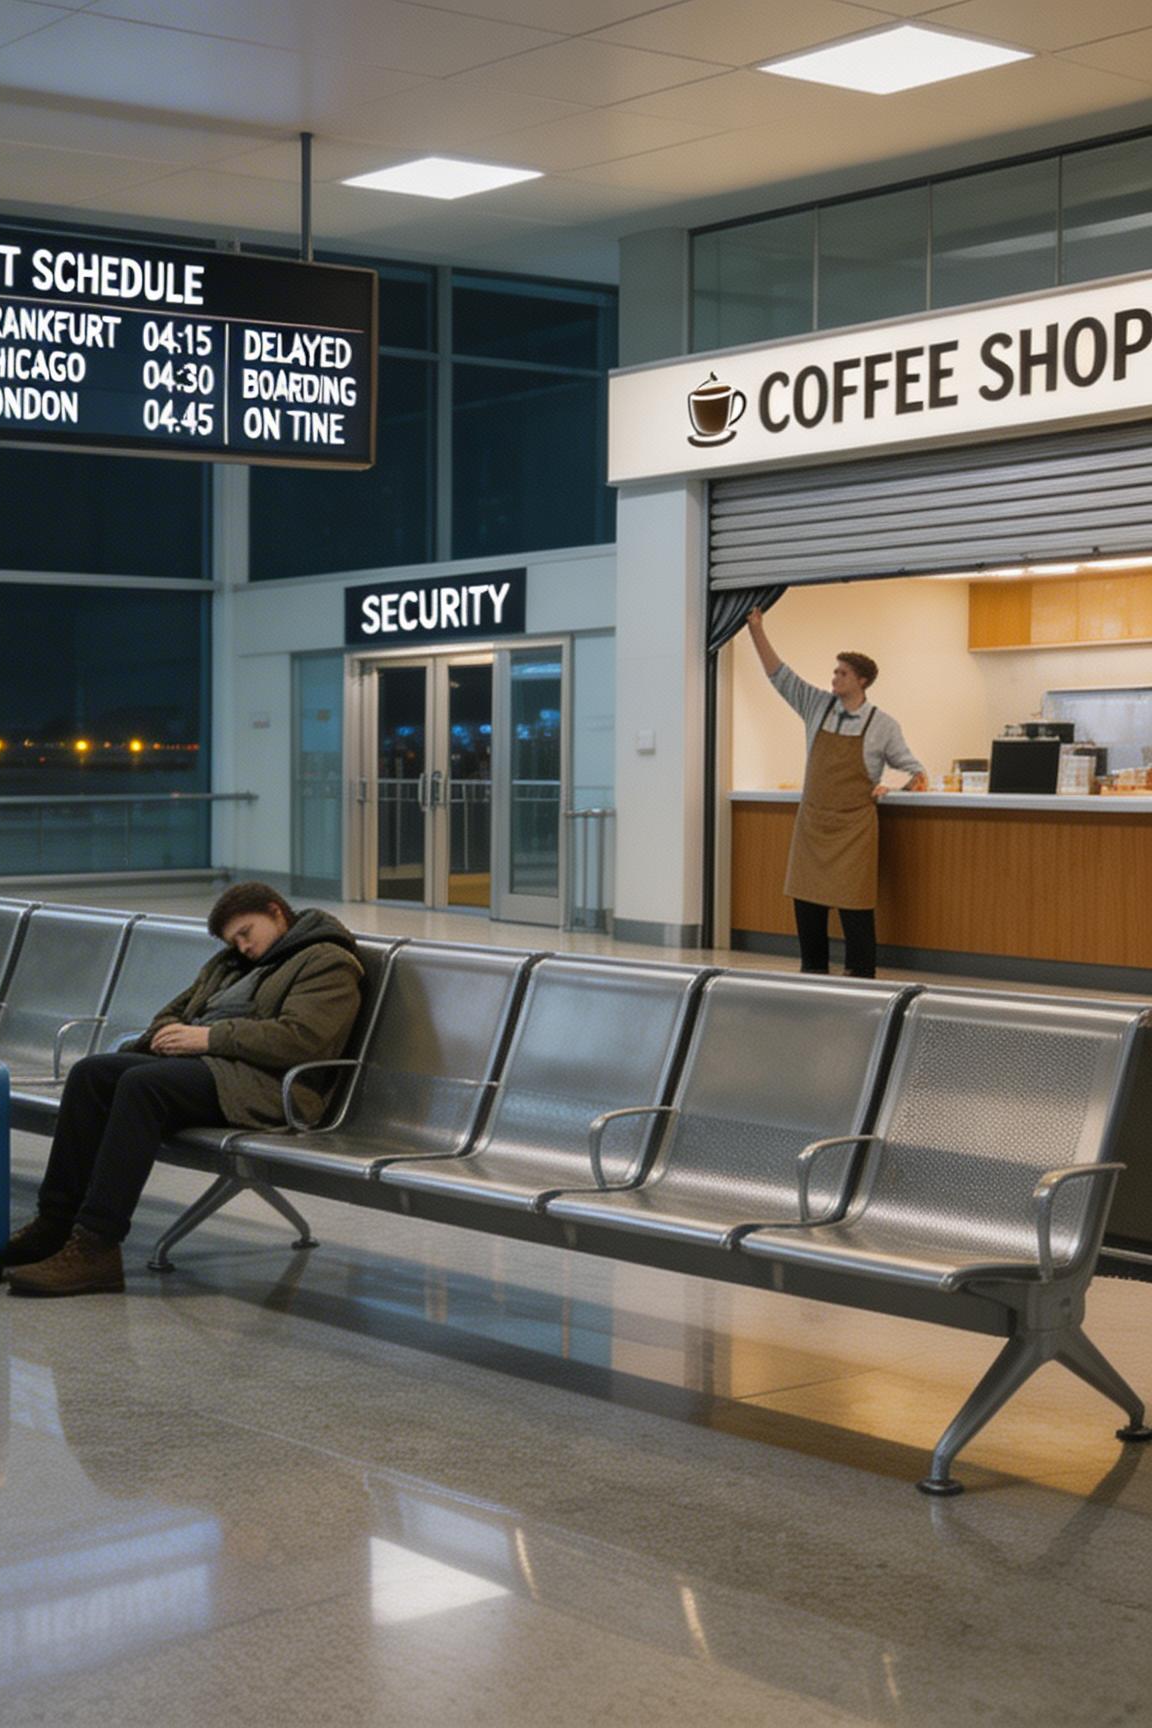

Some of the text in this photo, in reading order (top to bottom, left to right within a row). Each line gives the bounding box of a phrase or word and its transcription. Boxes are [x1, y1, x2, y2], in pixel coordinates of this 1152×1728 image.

[32, 248, 204, 305] SCHEDULE
[244, 329, 352, 369] DELAYED
[759, 308, 1152, 433] COFFEE SHOP
[242, 368, 357, 407] BOARDING
[243, 406, 281, 441] ON
[361, 582, 510, 634] SECURITY
